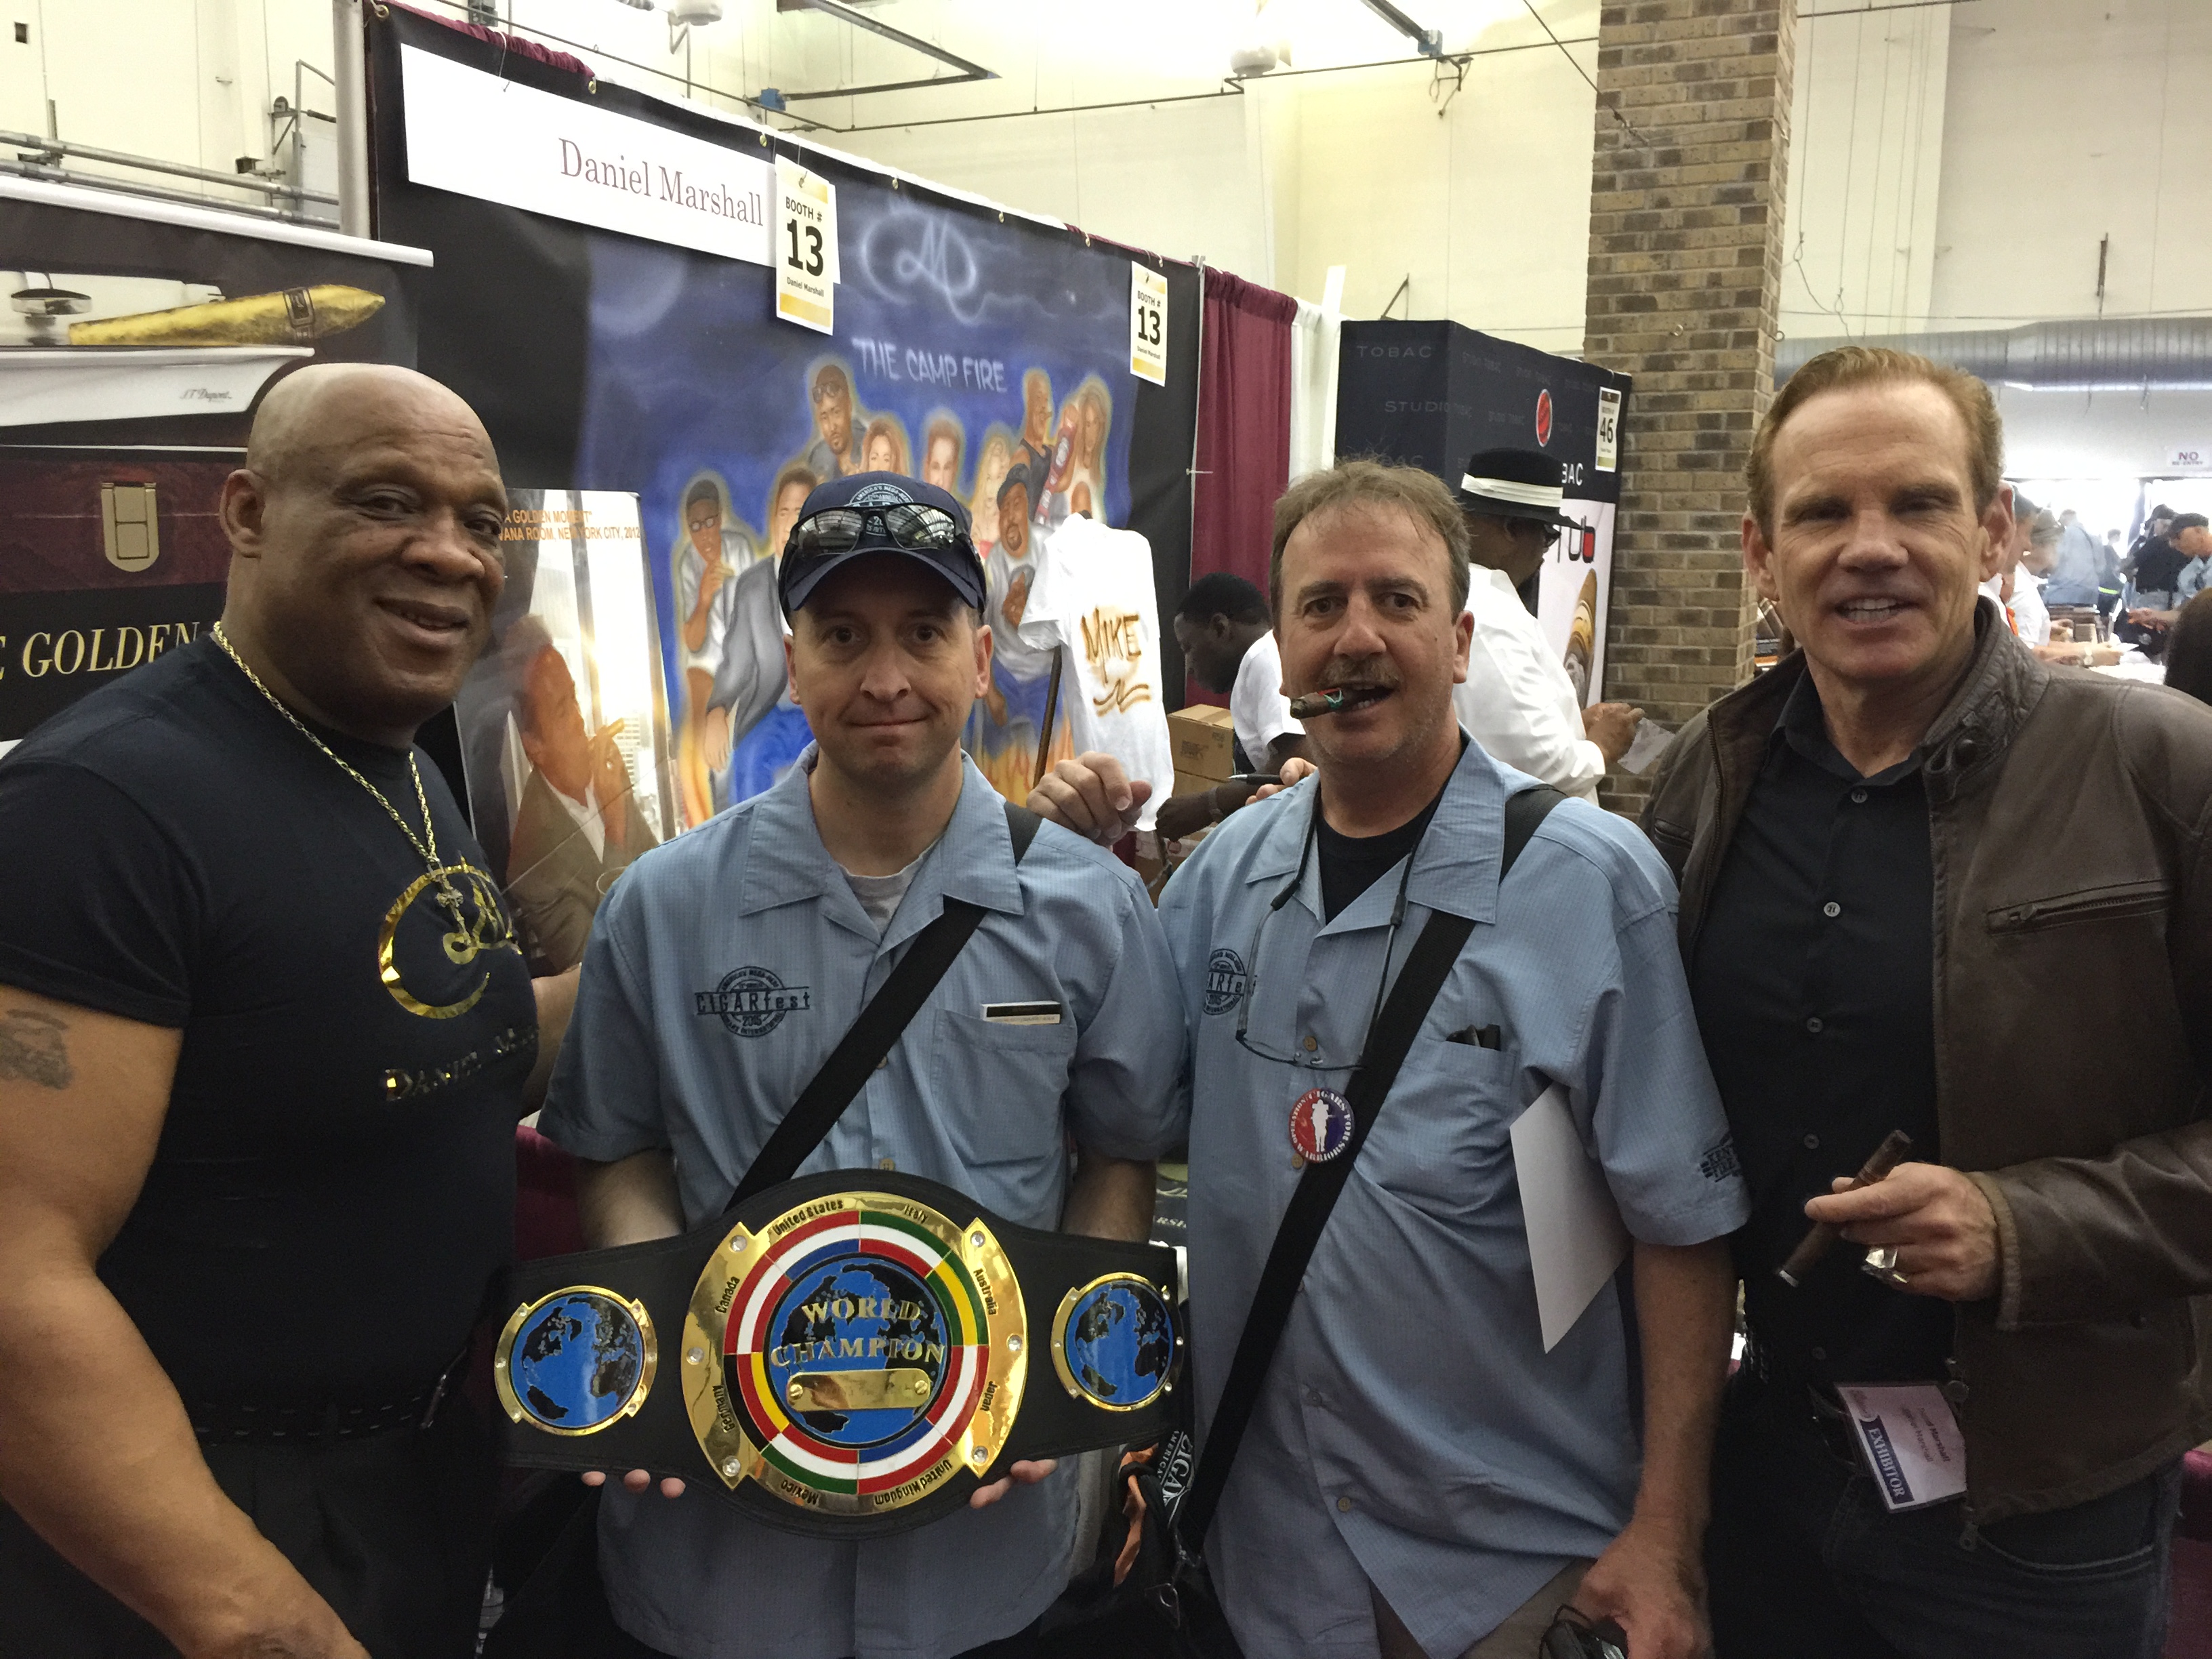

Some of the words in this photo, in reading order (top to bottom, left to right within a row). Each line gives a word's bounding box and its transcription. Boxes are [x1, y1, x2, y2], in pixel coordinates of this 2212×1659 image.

[558, 138, 651, 197] Daniel
[658, 166, 764, 226] Marshall
[786, 197, 814, 220] BOOTH
[817, 211, 823, 222] #
[787, 218, 823, 276] 13
[787, 276, 802, 289] Daniel
[804, 281, 824, 297] Marshall
[1137, 290, 1155, 306] BOOTH
[1138, 306, 1161, 346] 13
[853, 338, 900, 381] THE
[905, 348, 958, 388] CAMP
[962, 356, 1007, 393] FIRE
[1357, 346, 1432, 358] TOBAC
[1599, 417, 1614, 443] 46
[2178, 451, 2198, 460] NO
[512, 510, 551, 524] GOLDEN
[558, 527, 579, 539] NEW
[579, 527, 602, 539] YORK
[624, 526, 641, 539] 2012
[1080, 607, 1142, 671] MIKE
[696, 992, 810, 1013] CIGARfest
[1308, 1090, 1345, 1112] CIGARS
[1344, 1114, 1352, 1141] FOR
[1297, 1141, 1346, 1162] WARRIORS
[773, 1210, 806, 1235] United
[807, 1199, 843, 1218] States
[904, 1204, 928, 1225] Italy
[715, 1276, 740, 1314] Canada
[973, 1268, 998, 1315] Australia
[801, 1297, 921, 1323] WORLD
[771, 1337, 946, 1367] CHAMPION
[712, 1384, 736, 1433] Germany
[980, 1380, 998, 1412] Japan
[921, 1459, 952, 1490] United
[1867, 1427, 1906, 1497] EXHIBITOR
[781, 1479, 819, 1506] Mexico
[875, 1482, 920, 1505] Kingdom
